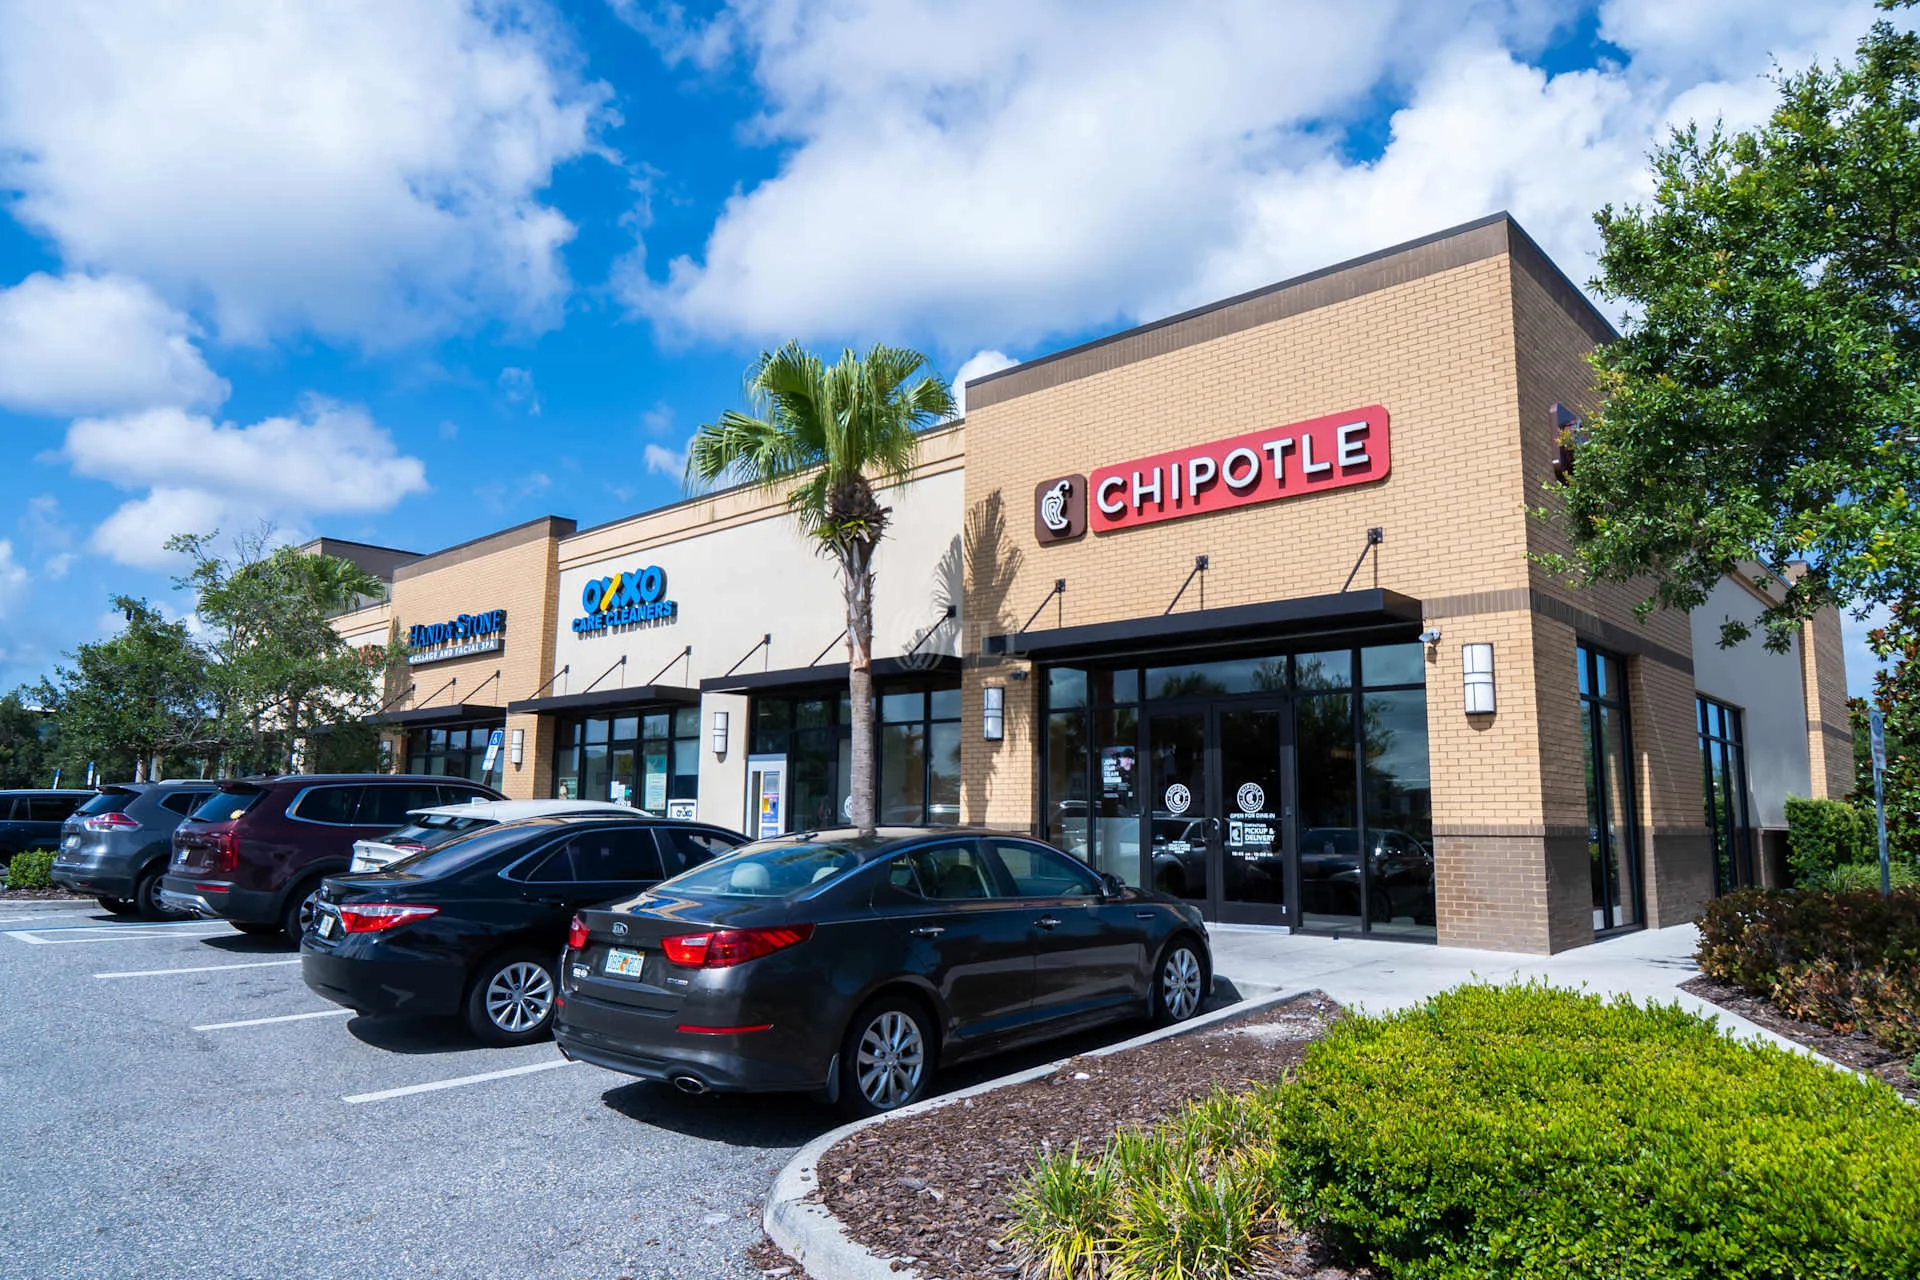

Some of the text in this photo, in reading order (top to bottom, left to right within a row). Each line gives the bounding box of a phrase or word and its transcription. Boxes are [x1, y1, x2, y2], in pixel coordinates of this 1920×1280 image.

[1096, 420, 1370, 514] CHIPOTLE
[582, 565, 662, 614] OXXO
[408, 609, 503, 648] HAND & STONE
[571, 599, 673, 633] CARE CLEANERS
[408, 640, 495, 664] MASSAGE AND FACIAL SPA
